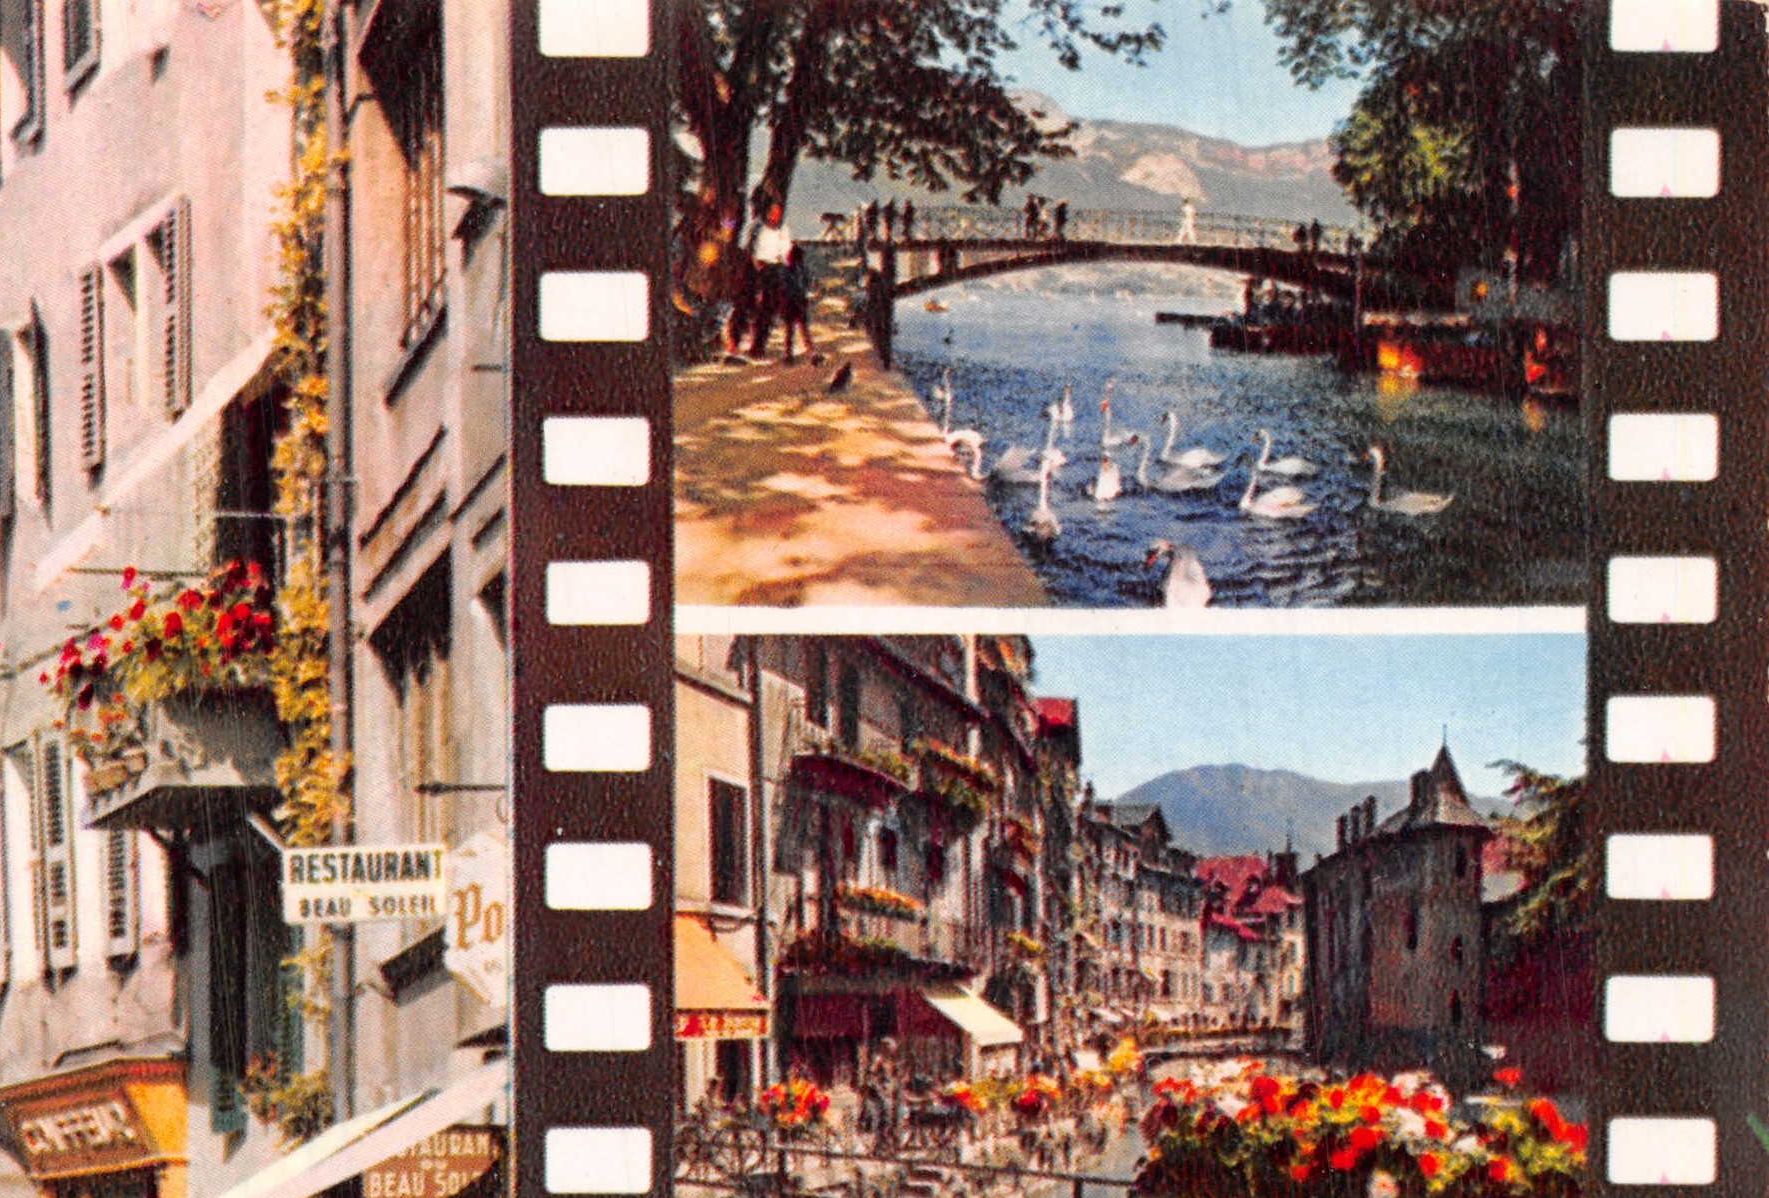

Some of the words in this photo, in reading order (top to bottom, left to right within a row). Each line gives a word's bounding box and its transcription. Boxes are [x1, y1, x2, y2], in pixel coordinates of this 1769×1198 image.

[288, 849, 444, 884] RESTAURANT
[298, 896, 352, 918] BEAU
[368, 893, 438, 916] SOLEIL
[368, 1172, 426, 1198] BEAU
